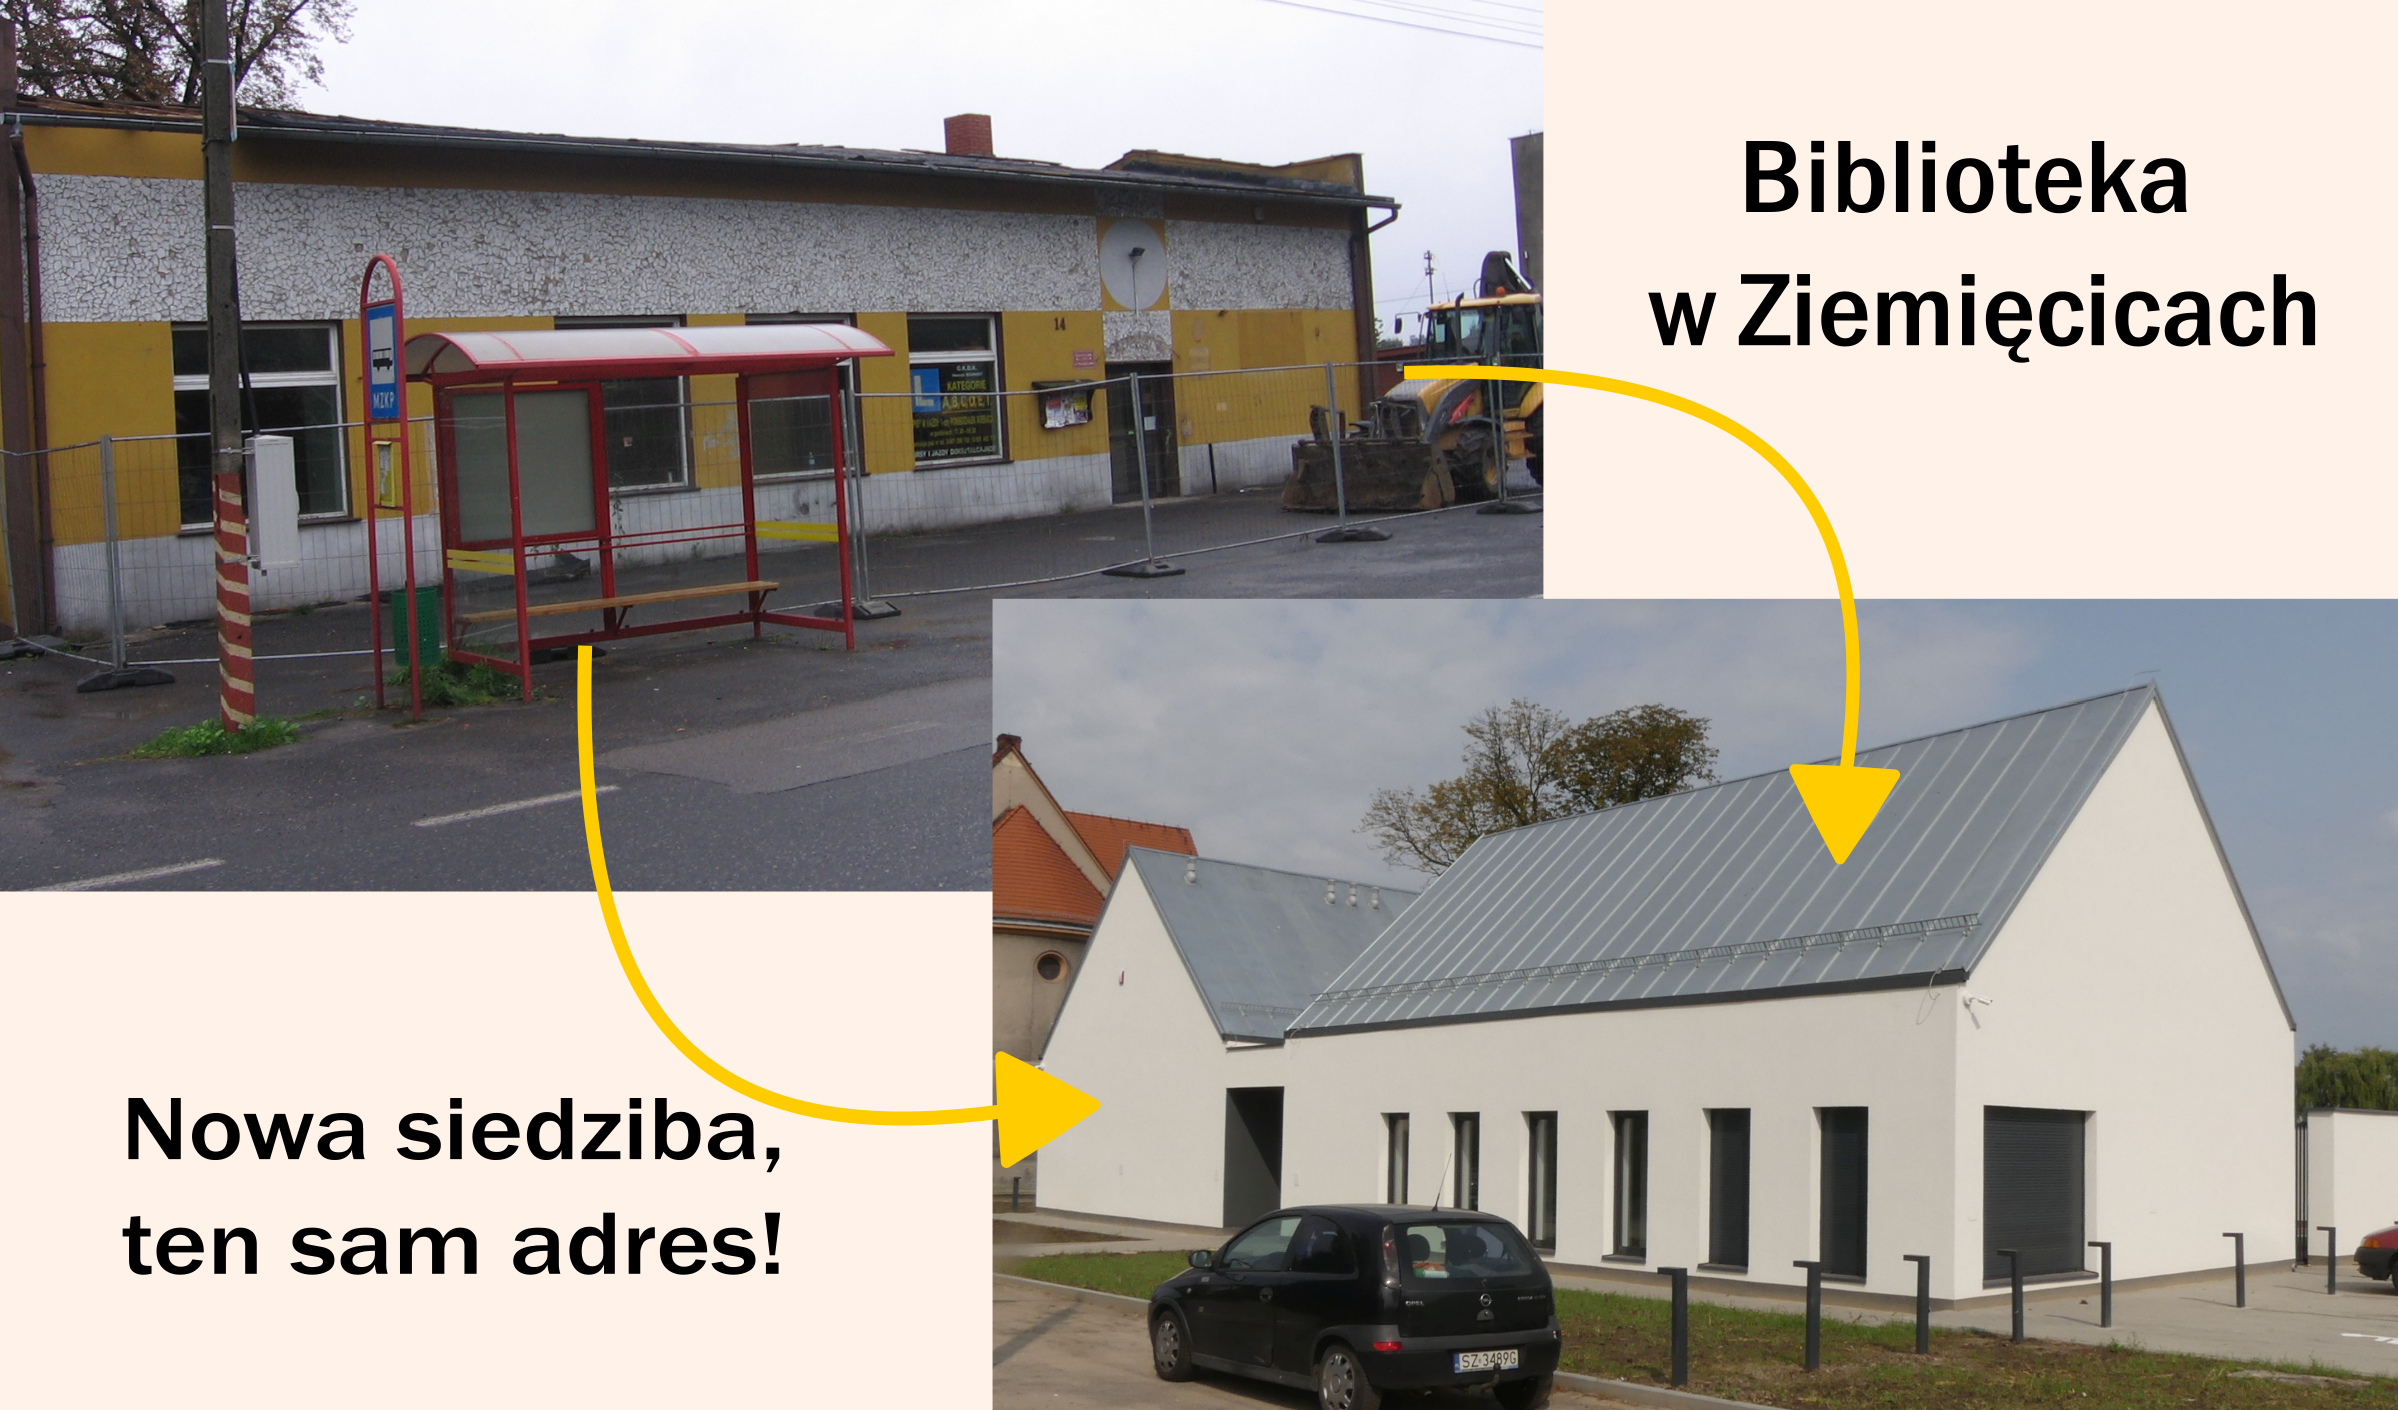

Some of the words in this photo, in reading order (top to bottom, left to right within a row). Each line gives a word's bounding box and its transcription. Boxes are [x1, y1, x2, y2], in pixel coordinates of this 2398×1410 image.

[1054, 317, 1066, 330] 14
[913, 375, 934, 407] L
[946, 380, 987, 391] KATEGORIE
[373, 391, 395, 409] MZKP
[1461, 1354, 1479, 1368] SZ
[1483, 1351, 1517, 1367] 3489G
